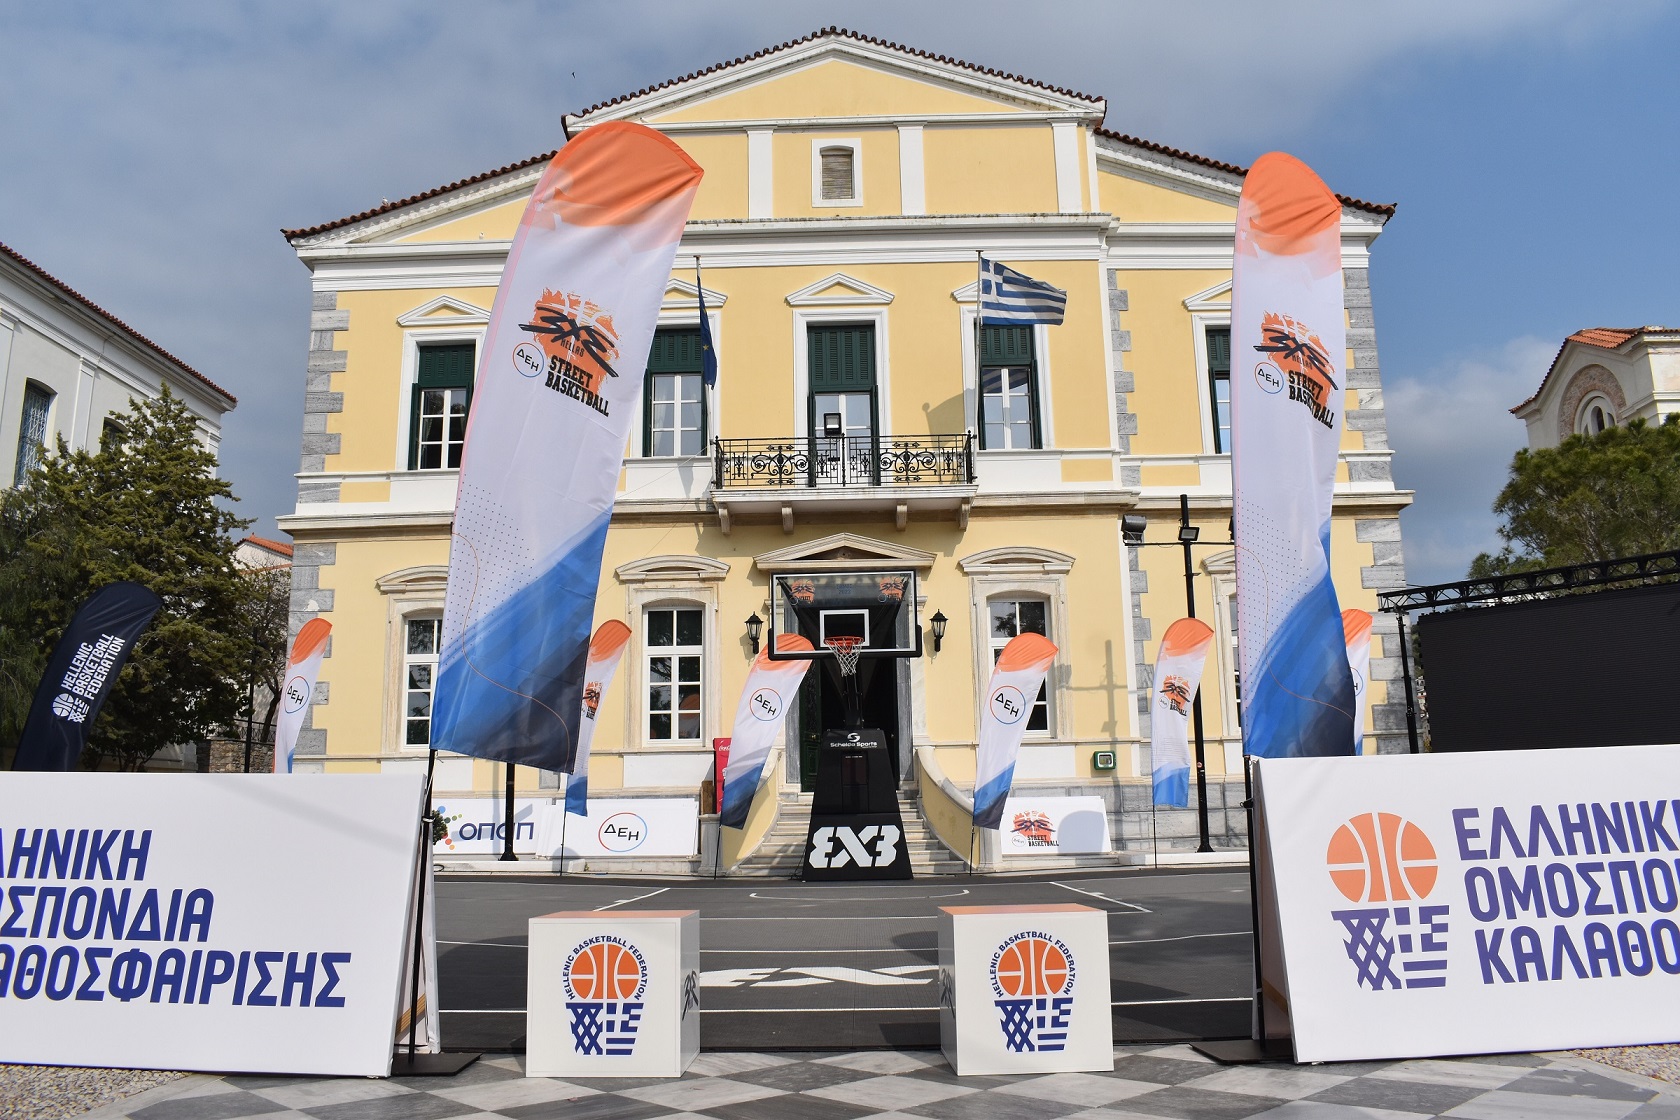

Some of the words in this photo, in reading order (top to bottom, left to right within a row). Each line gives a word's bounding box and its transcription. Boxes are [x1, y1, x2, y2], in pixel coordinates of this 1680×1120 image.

[516, 348, 540, 372] ΔΕΗ
[560, 339, 584, 358] HELLAS
[545, 371, 609, 418] BASKETBALL
[549, 355, 593, 389] STREET
[1257, 368, 1280, 388] ΔΕΗ
[1288, 369, 1323, 401] STREET
[1288, 384, 1335, 430] BASKETBALL
[61, 642, 93, 691] HELLENIC
[71, 633, 114, 696] BASKETBALL
[84, 636, 126, 701] FEDERATION
[287, 685, 305, 705] ΔΕΗ
[754, 693, 777, 716] ΔΕΗ
[995, 692, 1019, 718] ΔΕΗ
[0, 828, 152, 881] ΗΝΙΚΗ
[604, 823, 640, 841] ΔΕΗ
[0, 885, 215, 942] ΣΠΟΝΔΙΑ
[1464, 858, 1680, 923] ΟΜΟΣΠΟ
[562, 954, 576, 1001] HELLENIC
[573, 935, 627, 955] BASKETBALL
[628, 944, 648, 1001] FEDERATION
[989, 951, 1004, 998] HELLENIC
[998, 930, 1053, 953] BASKETBALL
[1054, 939, 1076, 996] FEDERATION
[1474, 918, 1680, 985] ΚΑΛΑΘΟ
